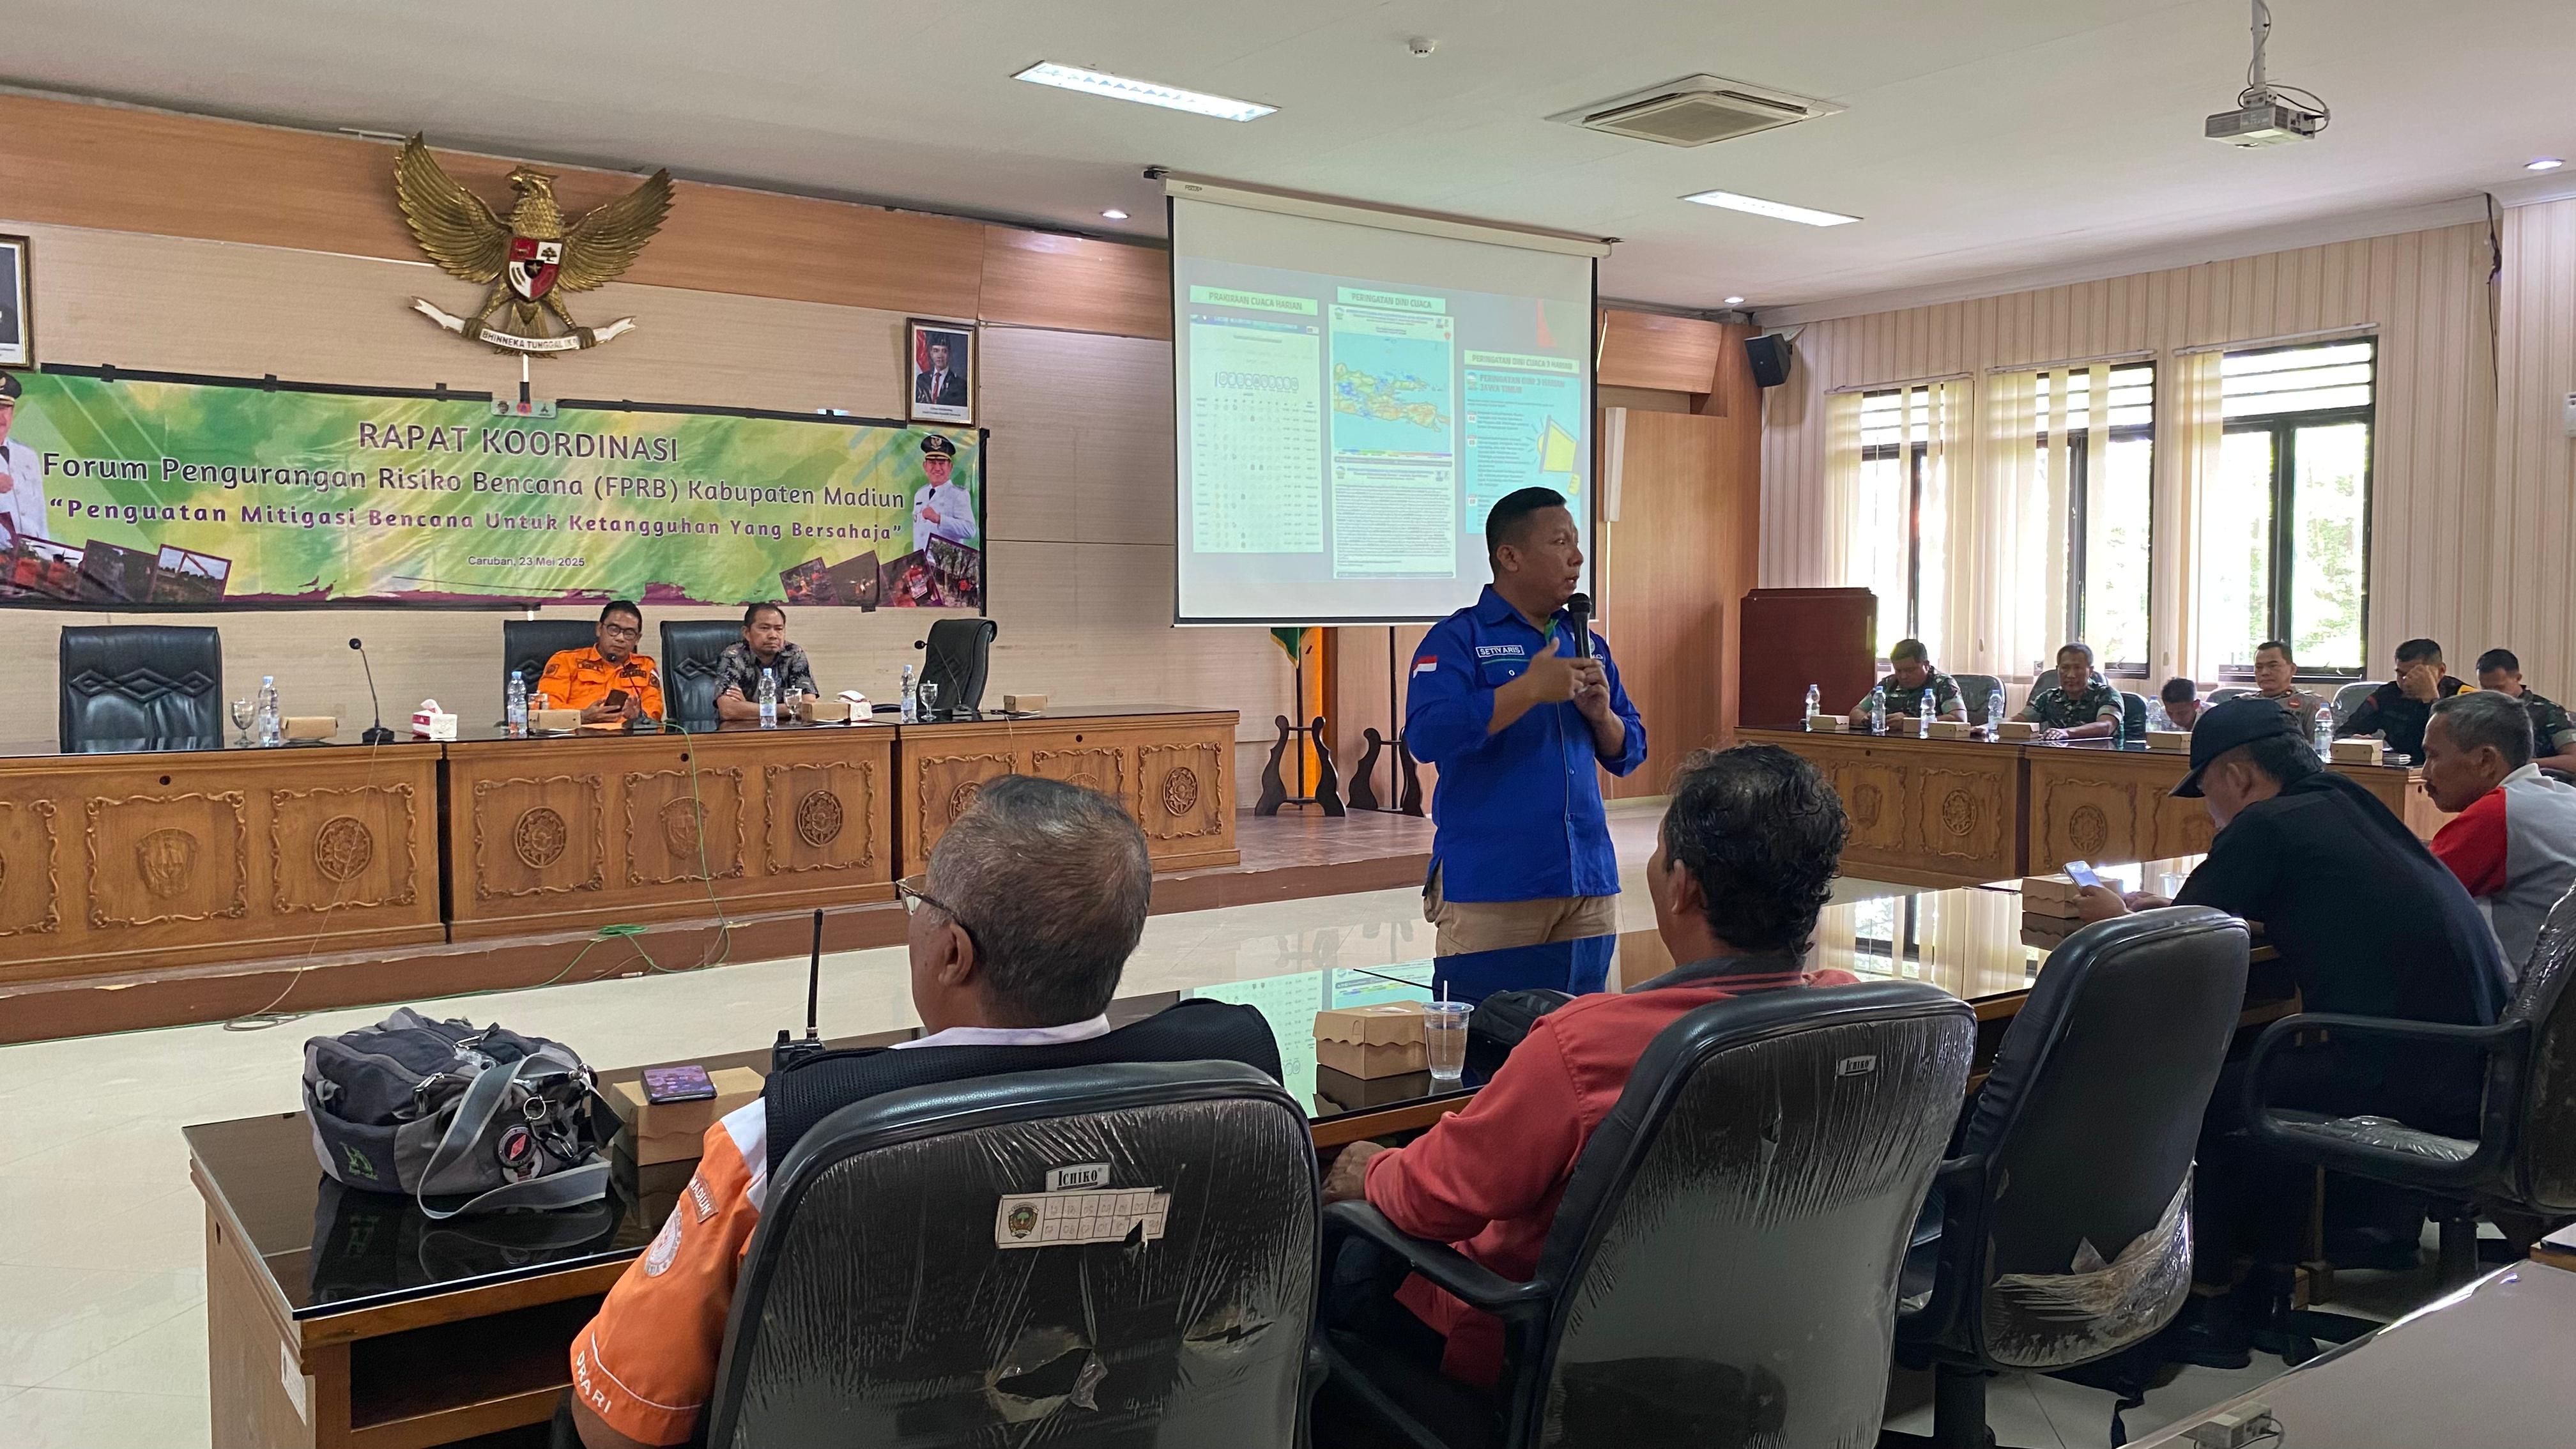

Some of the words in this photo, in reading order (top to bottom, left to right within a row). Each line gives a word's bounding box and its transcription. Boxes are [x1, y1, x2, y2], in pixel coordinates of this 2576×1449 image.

[1209, 292, 1250, 305] PRAKIRAAN
[1251, 297, 1274, 307] CUACA
[1276, 300, 1303, 310] HARIAN
[1351, 293, 1394, 305] PERINGATAN
[1395, 298, 1409, 307] DINI
[1410, 299, 1432, 309] CUACA
[482, 331, 525, 348] BHINNEKA
[359, 422, 468, 452] RAPAT
[482, 428, 678, 463] KOORDINASI
[43, 452, 148, 481] Forum
[162, 458, 366, 492] Pengurangan
[378, 467, 461, 492] Risiko
[473, 471, 583, 496] Bencana
[594, 475, 678, 503] (FPRB)
[689, 480, 814, 508] Kabupaten
[824, 486, 904, 509] Madiun
[50, 498, 226, 525] “Penguatan
[241, 505, 356, 528] Mitigasi
[369, 509, 474, 529] Bencana
[486, 512, 558, 530] Untuk
[569, 515, 719, 537] Ketangguhan
[730, 519, 781, 540] Yang
[792, 522, 901, 542] Bersahaja”
[468, 556, 516, 567] Caruban,
[519, 557, 533, 565] 23
[535, 557, 555, 566] Mei
[558, 558, 585, 566] 2025
[689, 1176, 711, 1215] MADIUN
